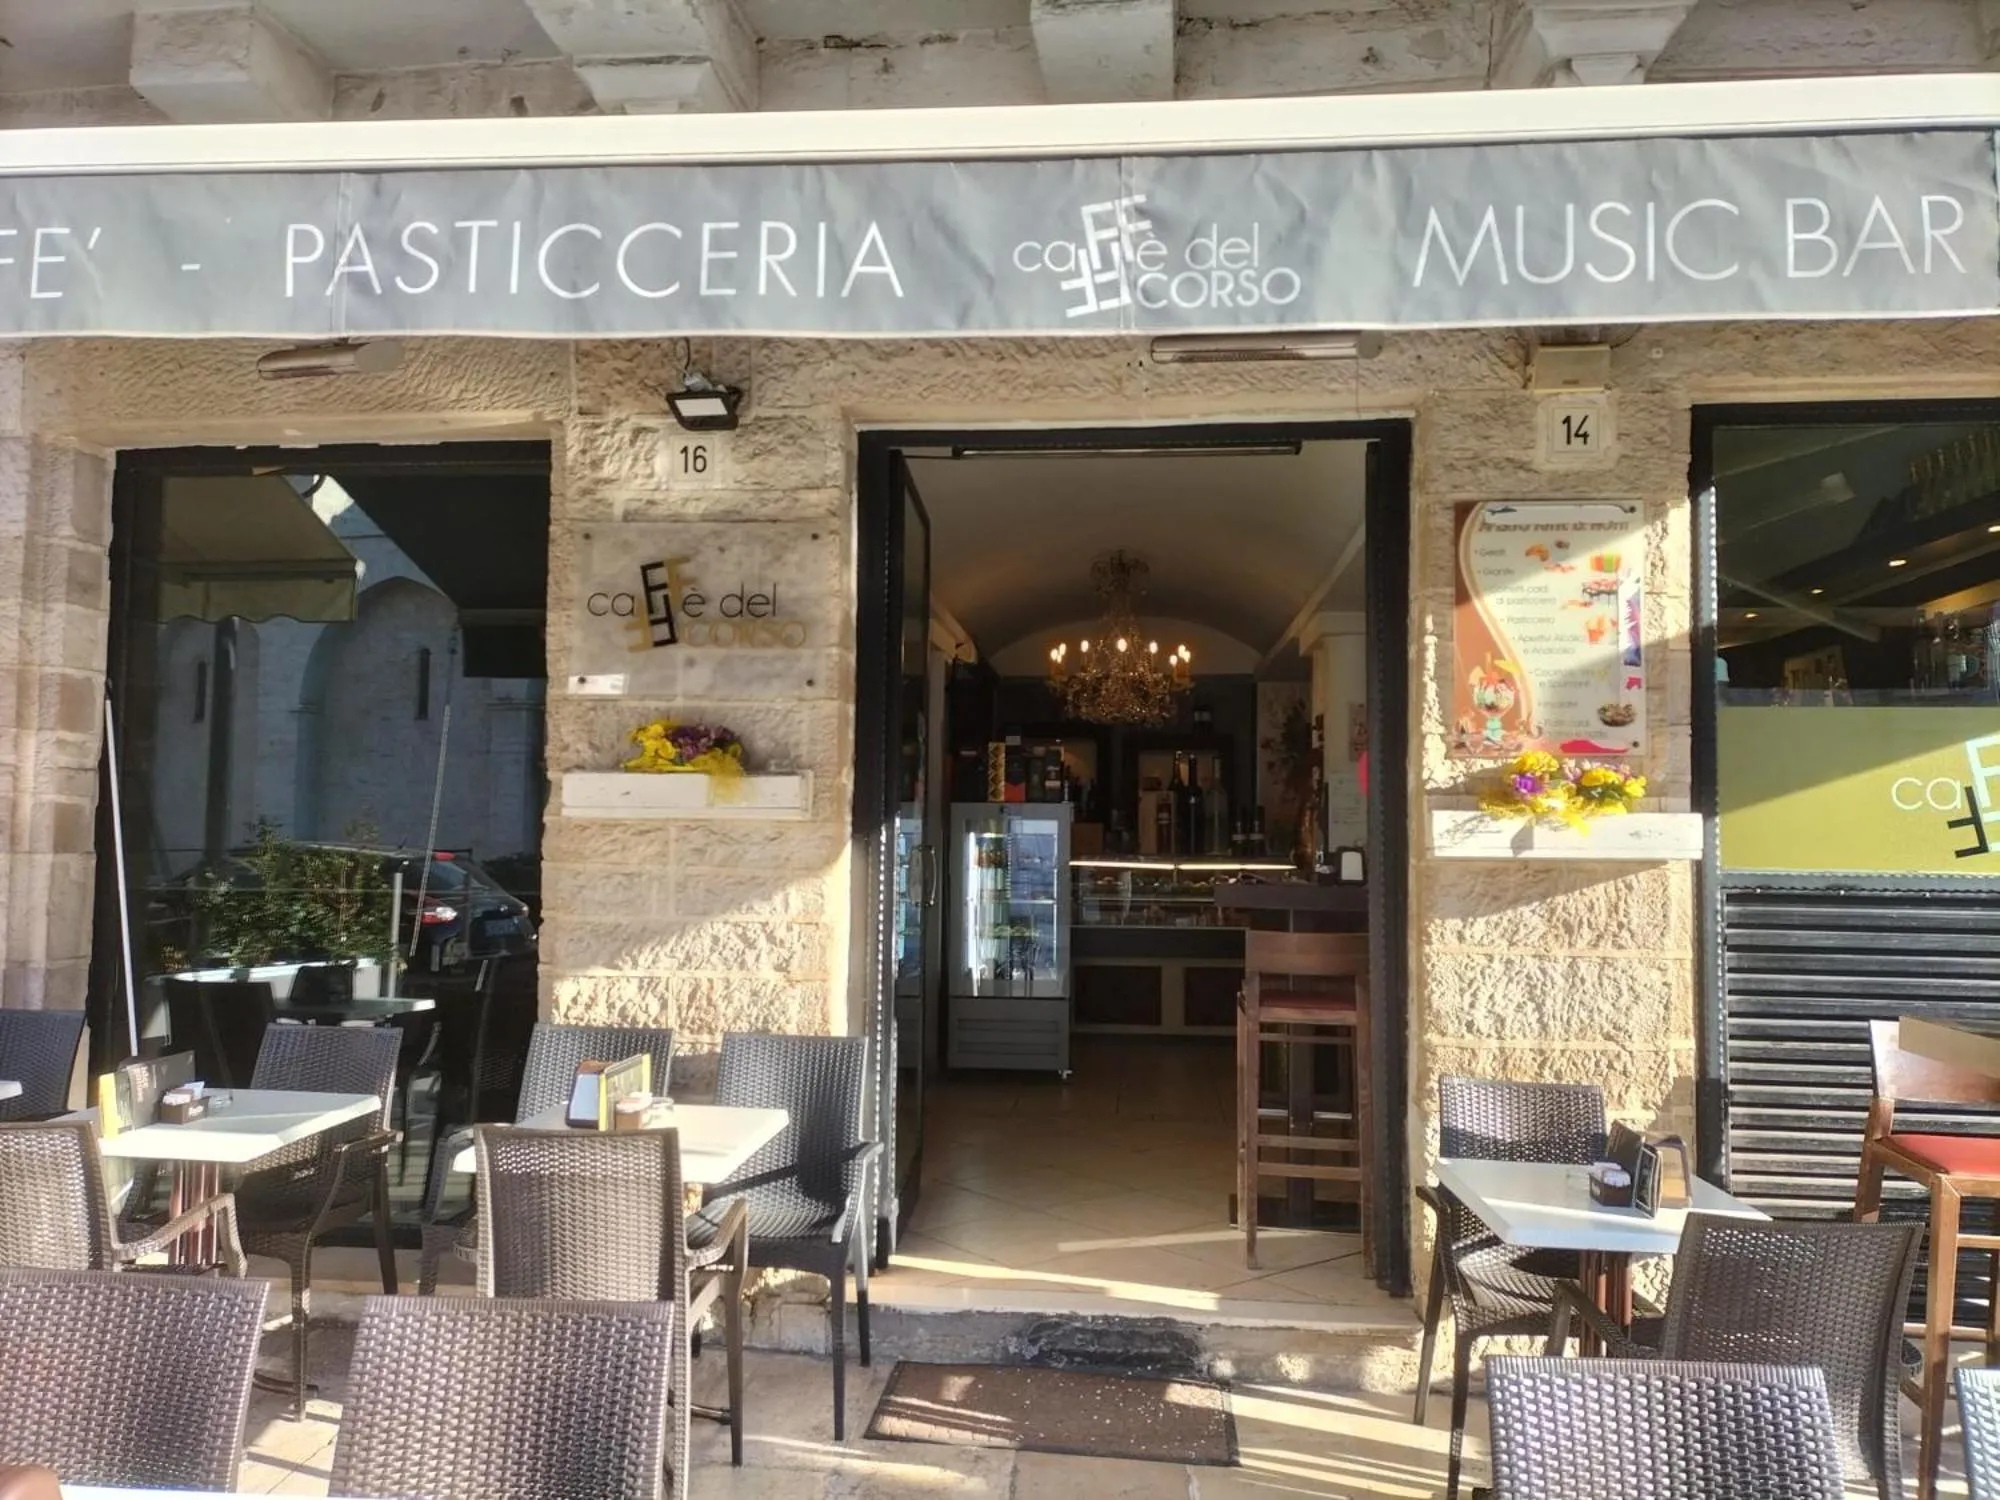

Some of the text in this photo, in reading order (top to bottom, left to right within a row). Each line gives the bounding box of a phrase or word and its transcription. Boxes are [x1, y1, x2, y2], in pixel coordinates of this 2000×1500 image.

[285, 219, 904, 298] PASTICCERIA
[1185, 221, 1259, 269] del
[1413, 194, 1967, 287] MUSIC BAR
[1136, 267, 1301, 308] CORSO
[1562, 414, 1590, 444] 14
[679, 445, 707, 473] 16
[720, 582, 777, 618] del
